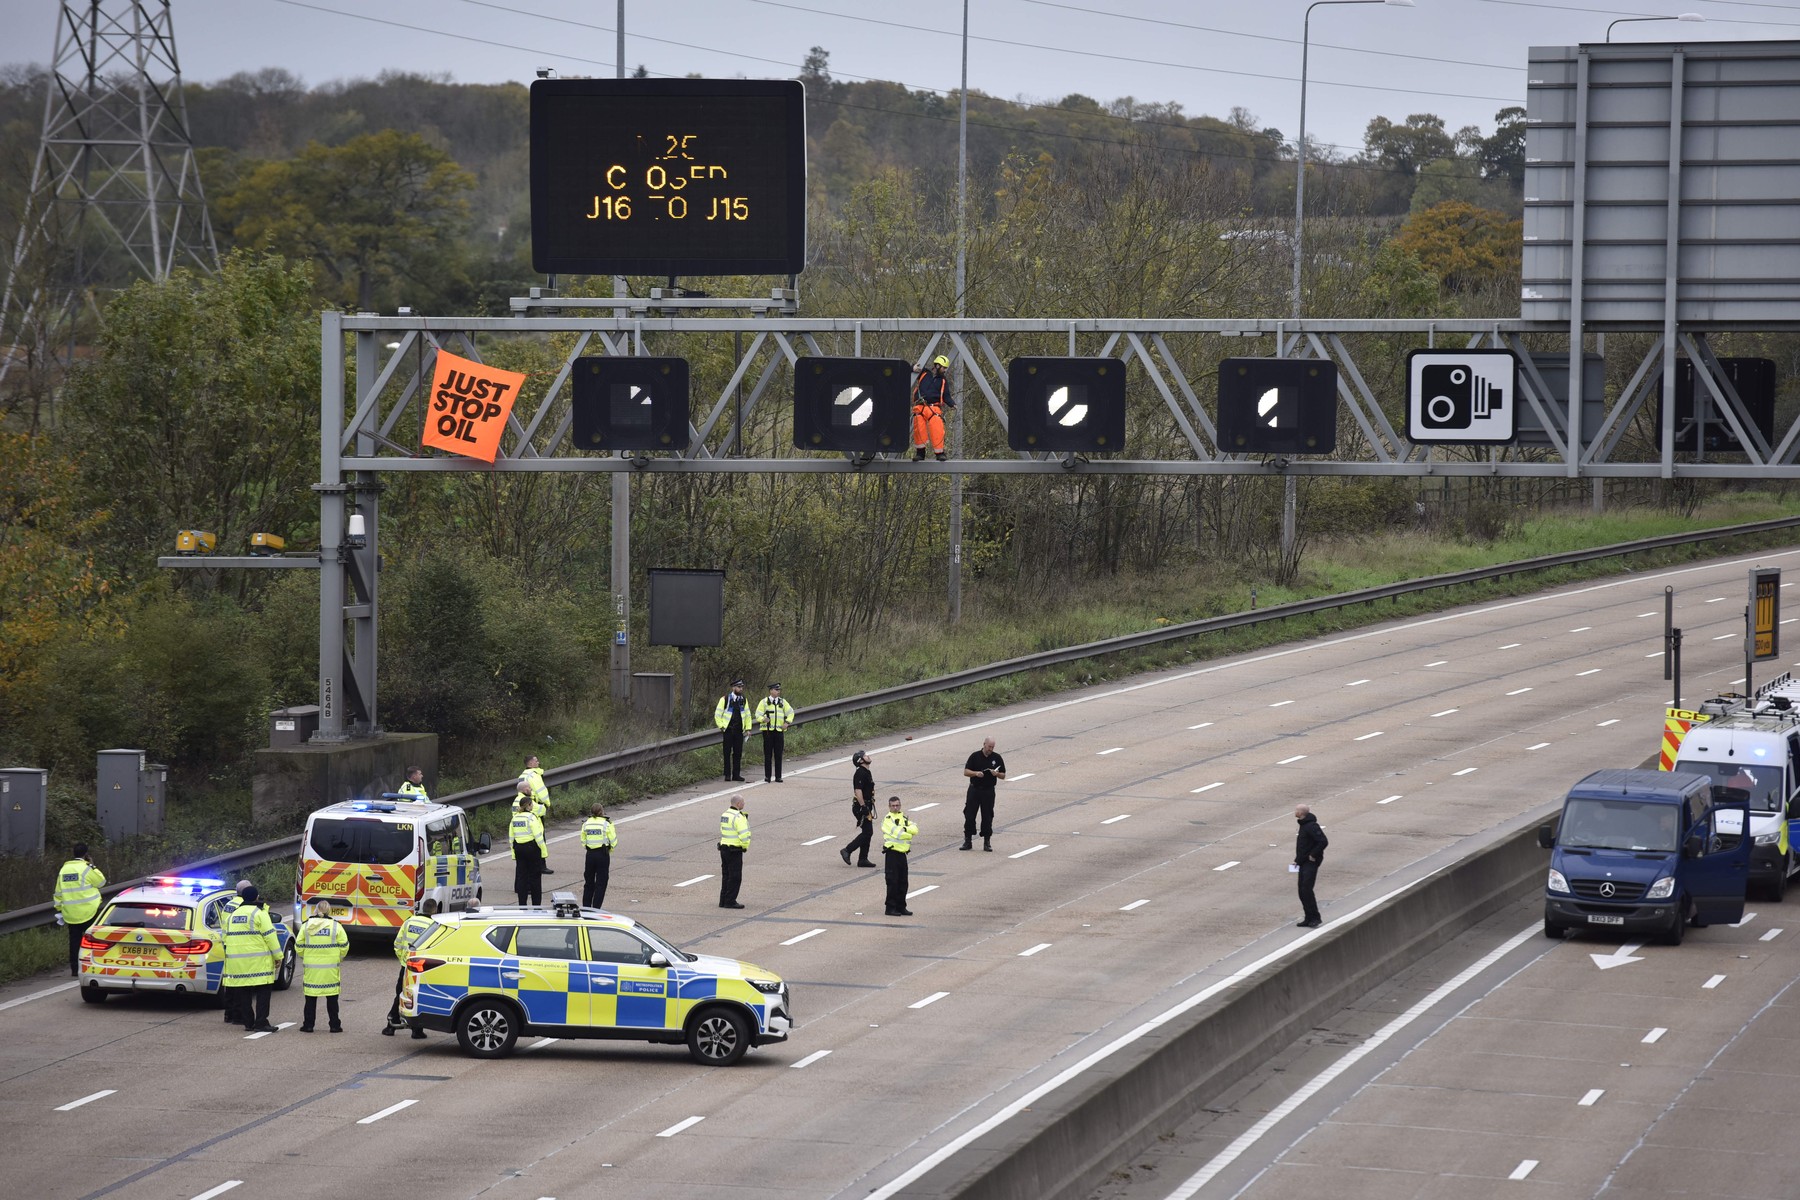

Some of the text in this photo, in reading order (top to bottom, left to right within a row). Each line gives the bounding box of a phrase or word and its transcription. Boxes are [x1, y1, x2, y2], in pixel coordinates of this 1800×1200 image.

[586, 195, 632, 220] J16
[705, 197, 749, 221] J15
[439, 370, 511, 402] JUST
[433, 390, 502, 423] STOP
[437, 415, 477, 443] OIL
[1665, 709, 1707, 722] ICE
[396, 823, 413, 831] LKN
[315, 882, 346, 892] POLICE
[370, 885, 401, 894] POLICE
[450, 886, 473, 900] POLICE
[331, 908, 345, 916] HGC
[410, 925, 426, 934] POLIC
[122, 946, 158, 956] CX68 BYC
[103, 958, 174, 968] POLICE
[520, 962, 568, 970] www.met.police.uk
